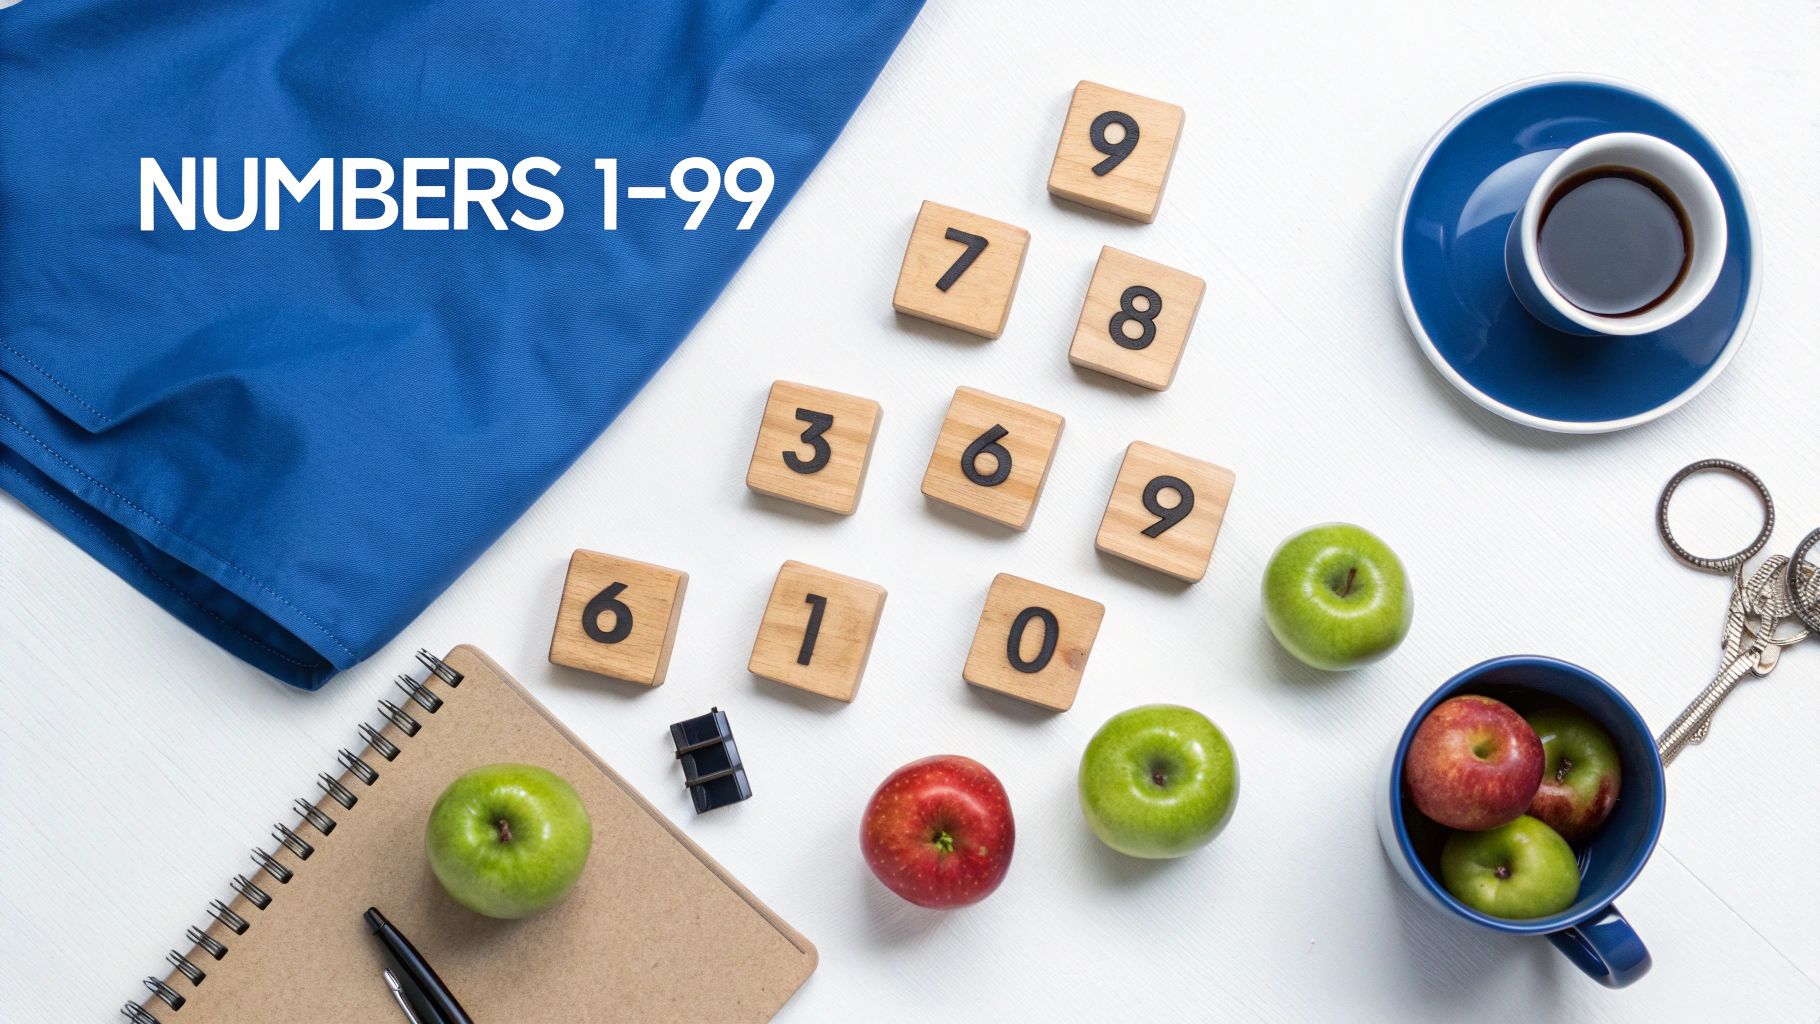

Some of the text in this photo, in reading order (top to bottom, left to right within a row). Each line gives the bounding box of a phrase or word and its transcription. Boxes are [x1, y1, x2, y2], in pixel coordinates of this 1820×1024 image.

[1090, 111, 1140, 176] 9
[936, 228, 988, 292] 7
[1109, 286, 1162, 350] 8
[783, 408, 833, 474] 3
[961, 424, 1012, 487] 6
[1141, 476, 1194, 538] 9
[582, 582, 633, 644] 6
[797, 594, 826, 665] 1
[1007, 607, 1059, 673] 0
